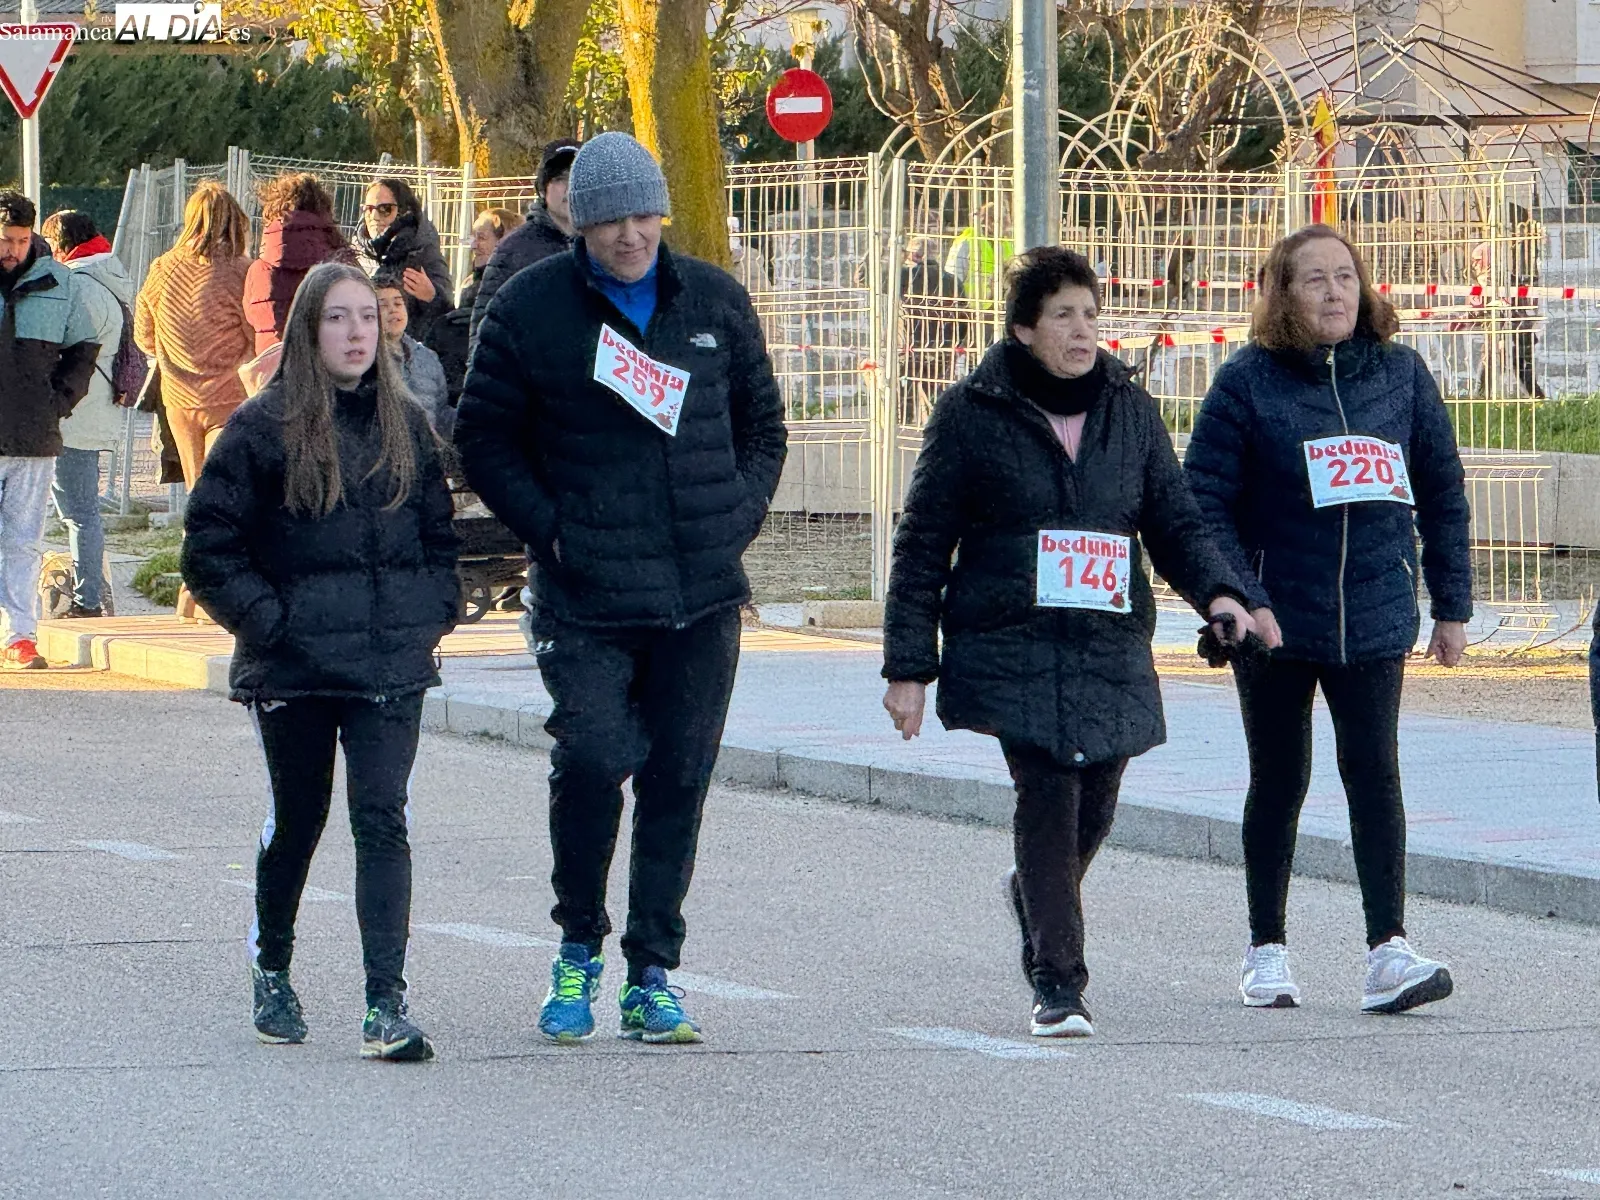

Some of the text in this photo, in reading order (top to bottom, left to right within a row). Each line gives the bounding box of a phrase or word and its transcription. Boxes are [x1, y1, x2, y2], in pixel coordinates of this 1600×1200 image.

[612, 355, 666, 408] 259
[1308, 439, 1402, 462] bedunia
[1327, 456, 1395, 488] 220
[1041, 534, 1128, 559] bedunia
[1058, 555, 1117, 592] 146
